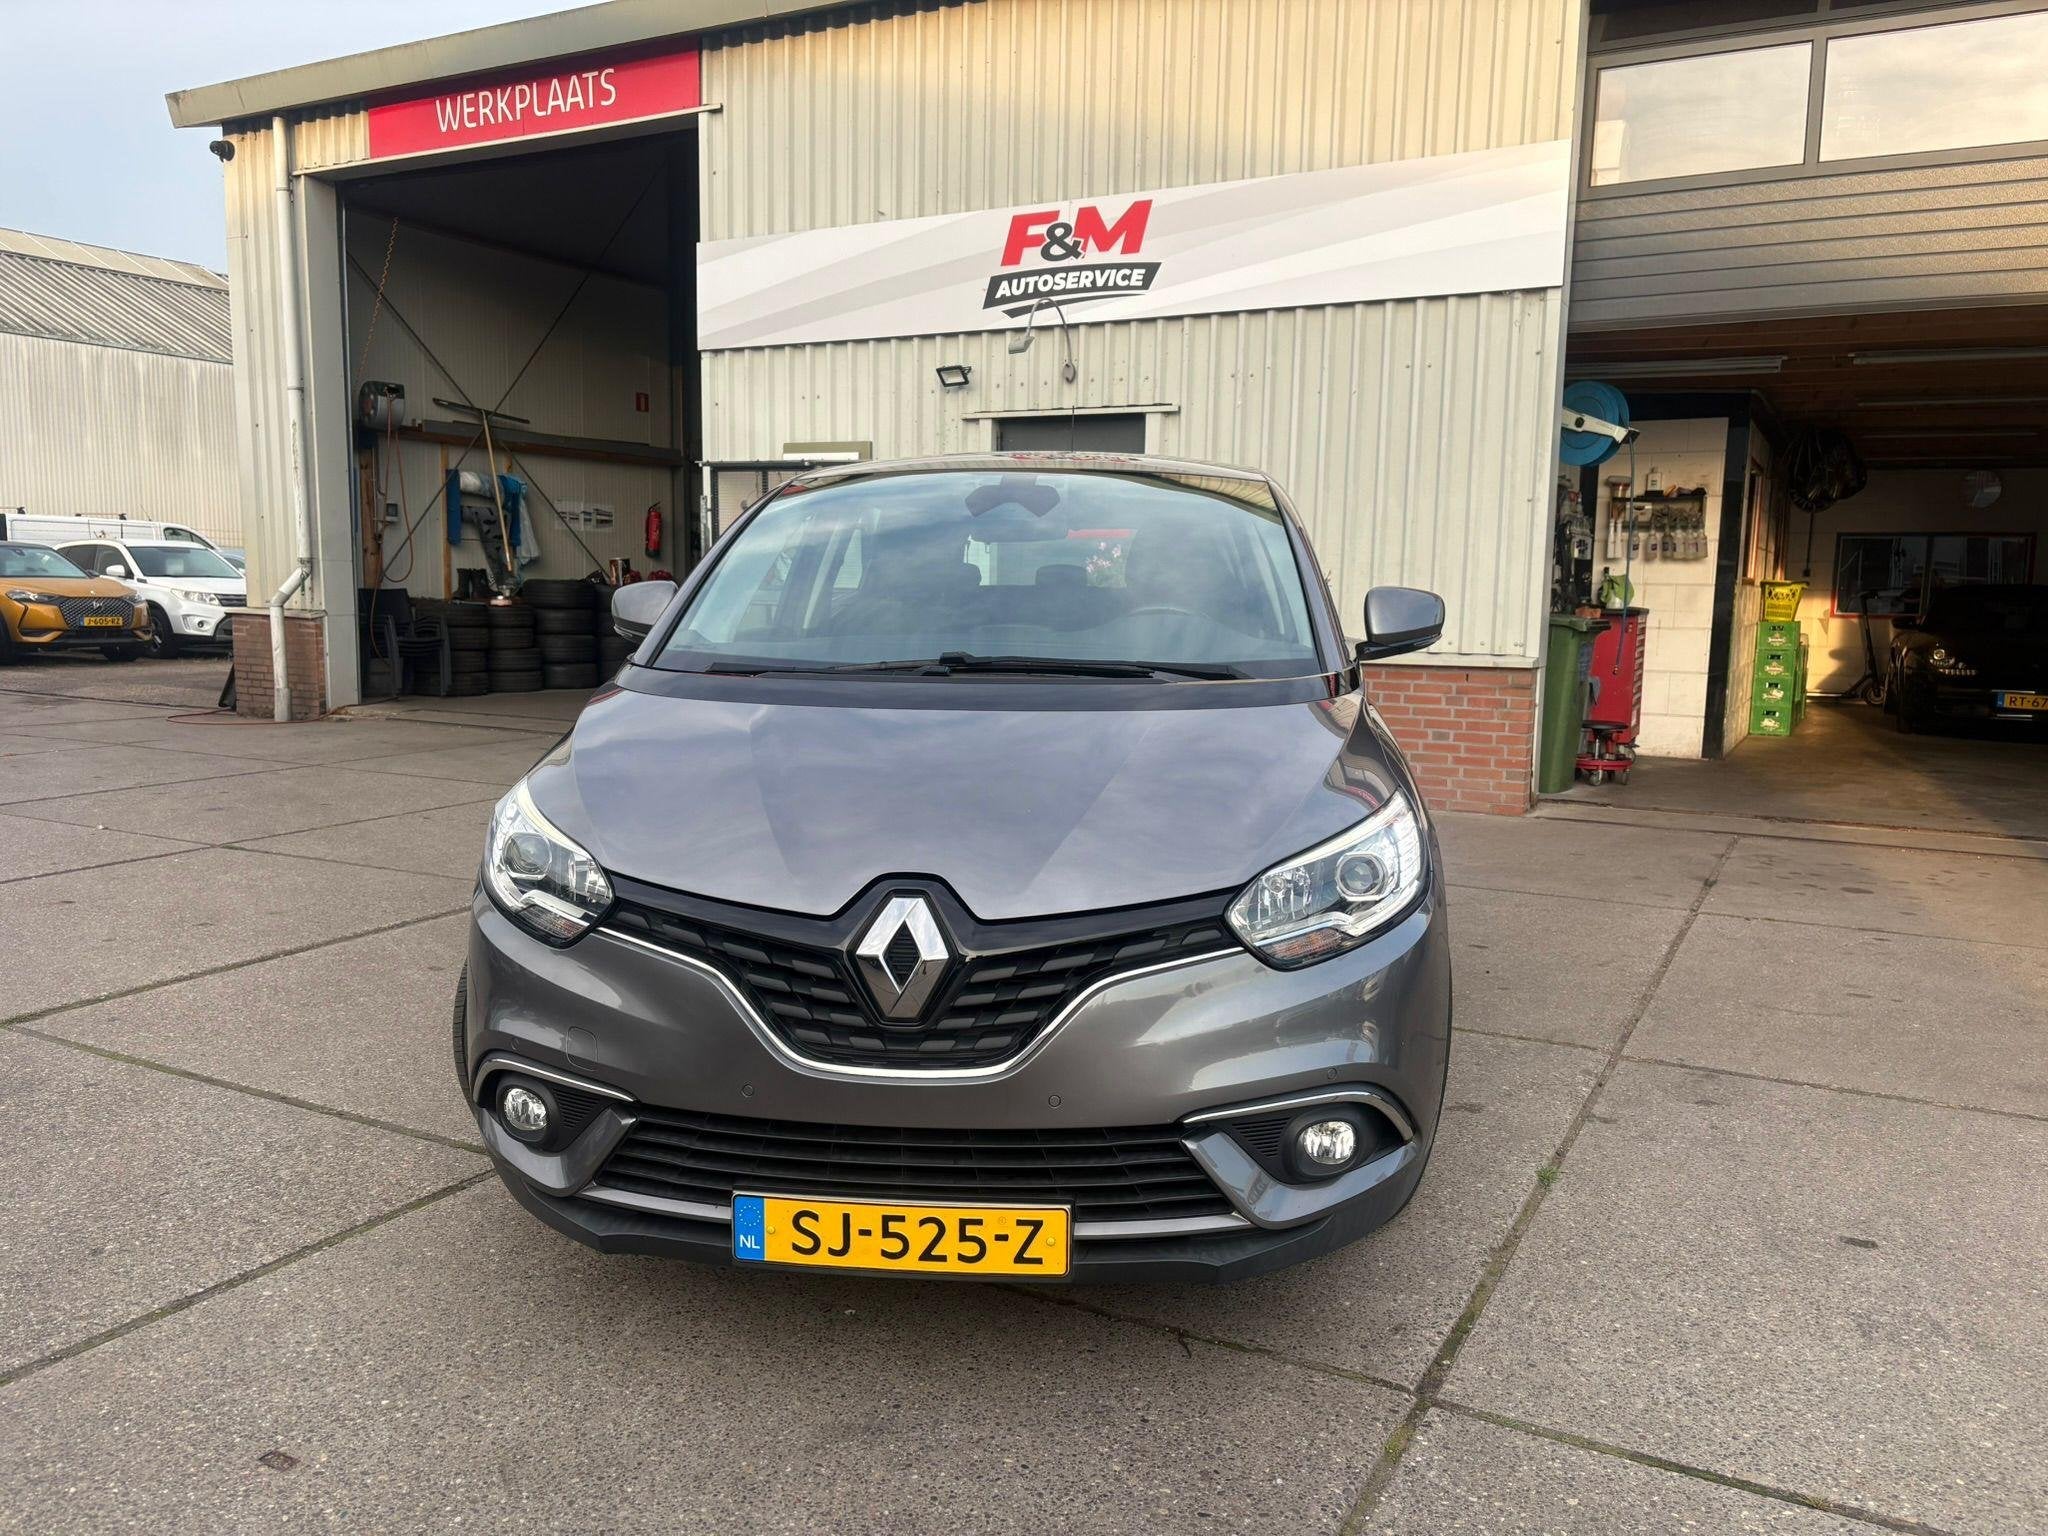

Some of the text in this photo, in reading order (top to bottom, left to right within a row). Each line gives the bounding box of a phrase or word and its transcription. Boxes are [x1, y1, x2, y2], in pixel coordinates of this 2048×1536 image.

[435, 68, 617, 133] WERKPLAATS
[1001, 199, 1154, 266] F&M
[994, 268, 1147, 299] AUTOSERVICE
[87, 616, 121, 626] J-605-RZ
[738, 1209, 1044, 1266] NL SJ-525-Z
